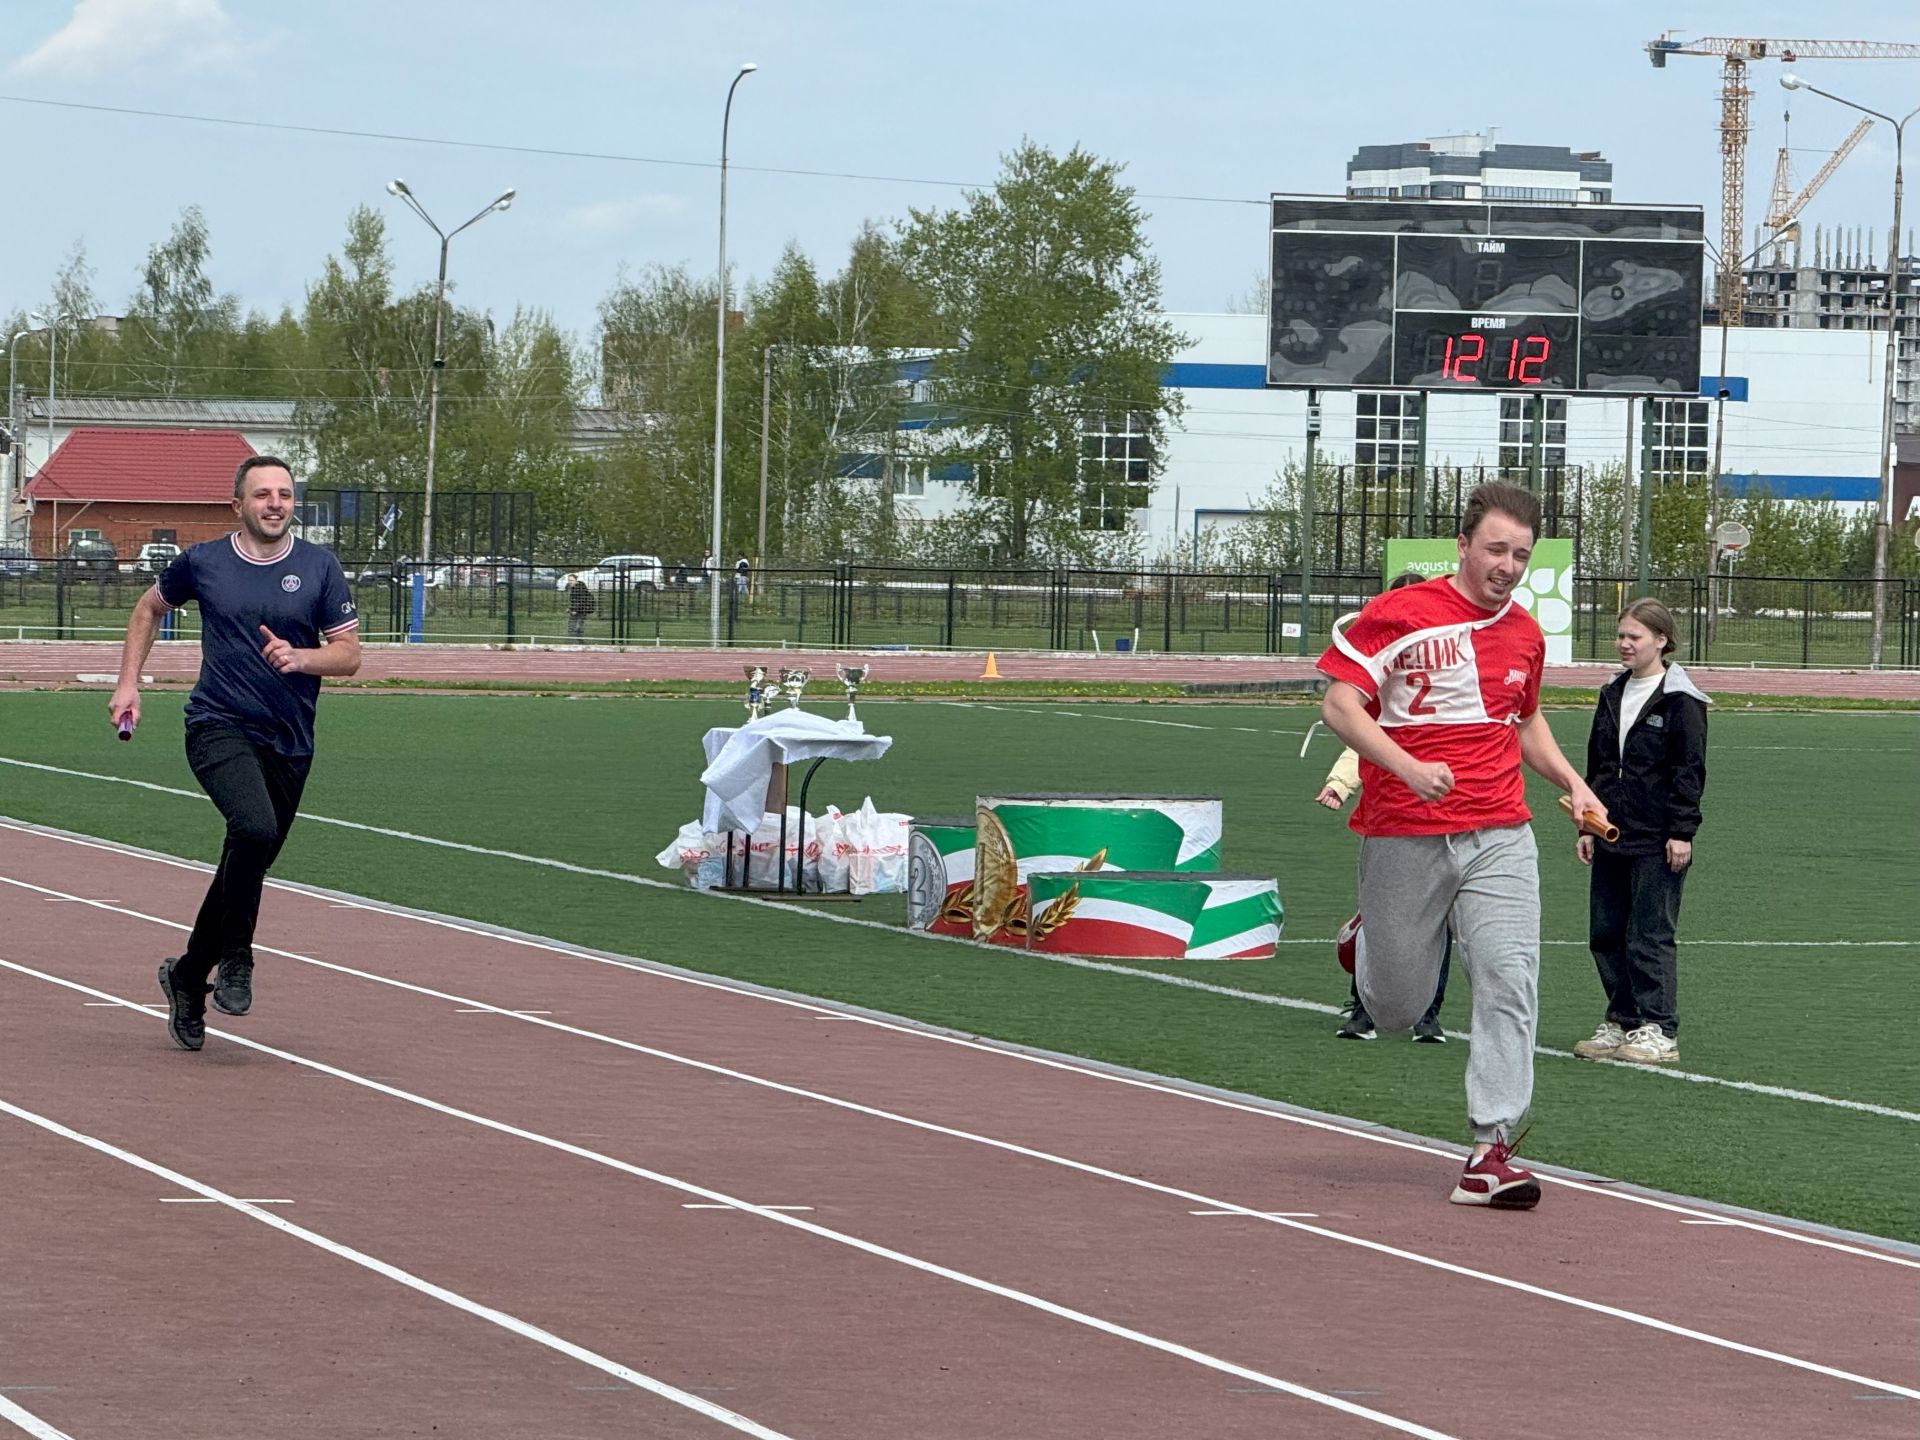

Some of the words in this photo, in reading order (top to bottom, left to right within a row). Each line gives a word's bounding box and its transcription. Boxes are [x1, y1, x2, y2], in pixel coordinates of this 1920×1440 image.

[1477, 239, 1506, 253] ТАЙМ
[1471, 317, 1506, 329] ВРЕМЯ
[1442, 334, 1485, 382] 12
[1507, 336, 1550, 384] 12
[1407, 560, 1449, 575] avgust
[1406, 671, 1436, 716] 2
[910, 856, 926, 906] 2
